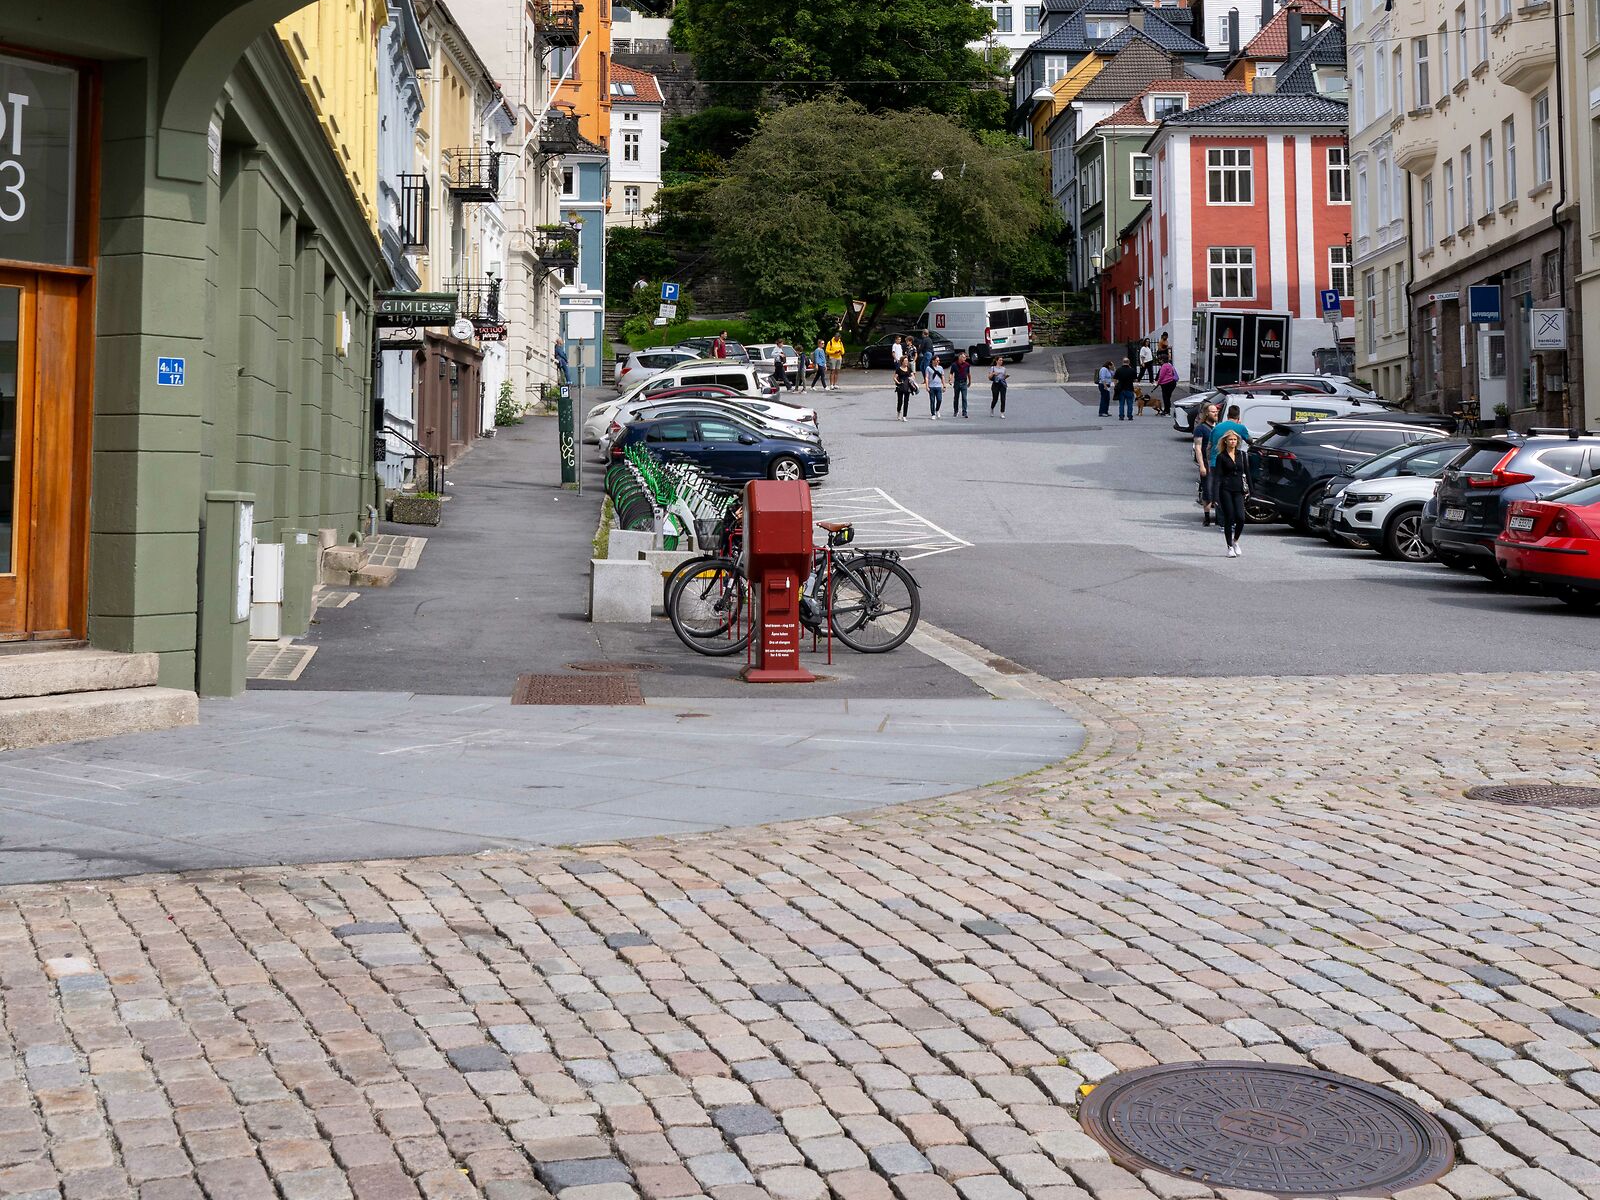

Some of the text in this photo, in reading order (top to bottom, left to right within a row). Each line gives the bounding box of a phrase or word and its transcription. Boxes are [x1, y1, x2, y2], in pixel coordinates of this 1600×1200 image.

[0, 91, 29, 156] T
[666, 285, 675, 297] P
[1326, 292, 1336, 309] P
[381, 301, 428, 312] GIMLE
[1218, 338, 1238, 347] VMB
[1260, 340, 1281, 348] VMB
